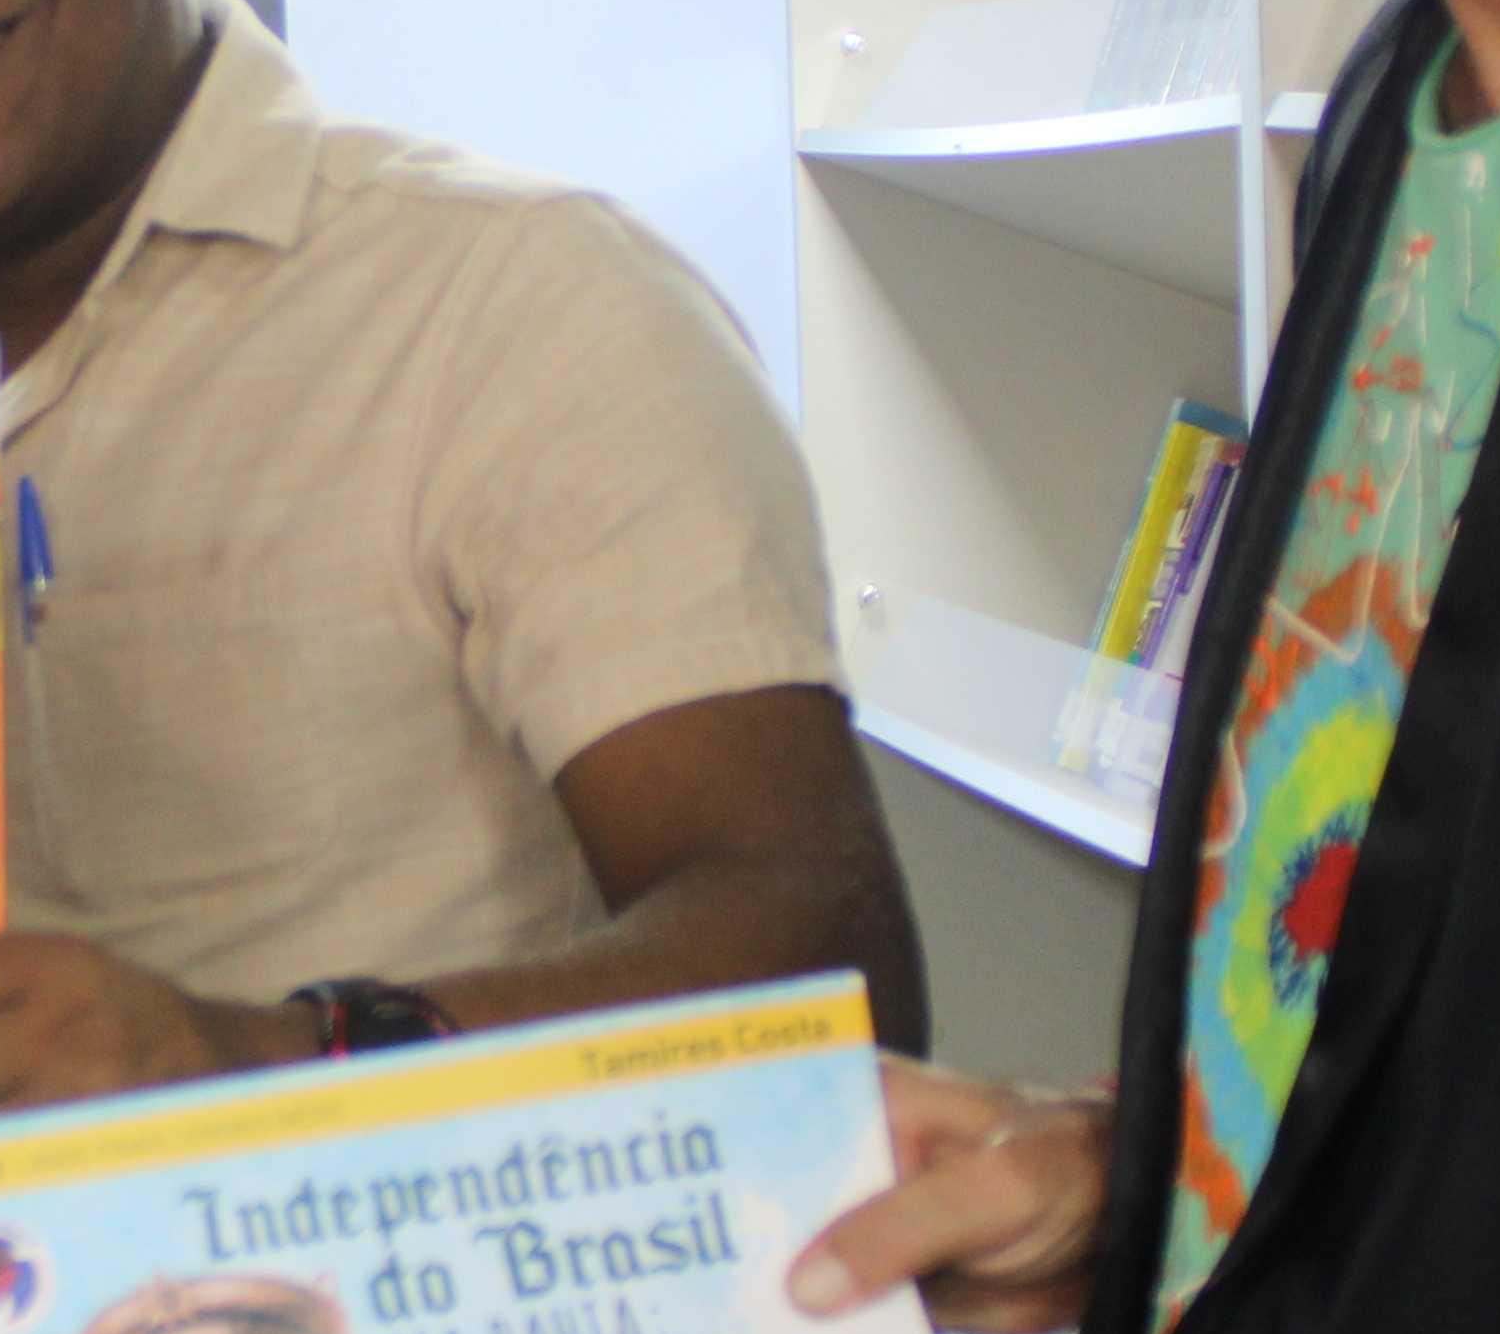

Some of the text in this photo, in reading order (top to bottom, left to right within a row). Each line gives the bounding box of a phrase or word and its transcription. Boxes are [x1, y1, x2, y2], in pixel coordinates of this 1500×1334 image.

[579, 1015, 833, 1080] Tamires Costa
[180, 1110, 725, 1262] Independência
[366, 1189, 740, 1325] do Brasil
